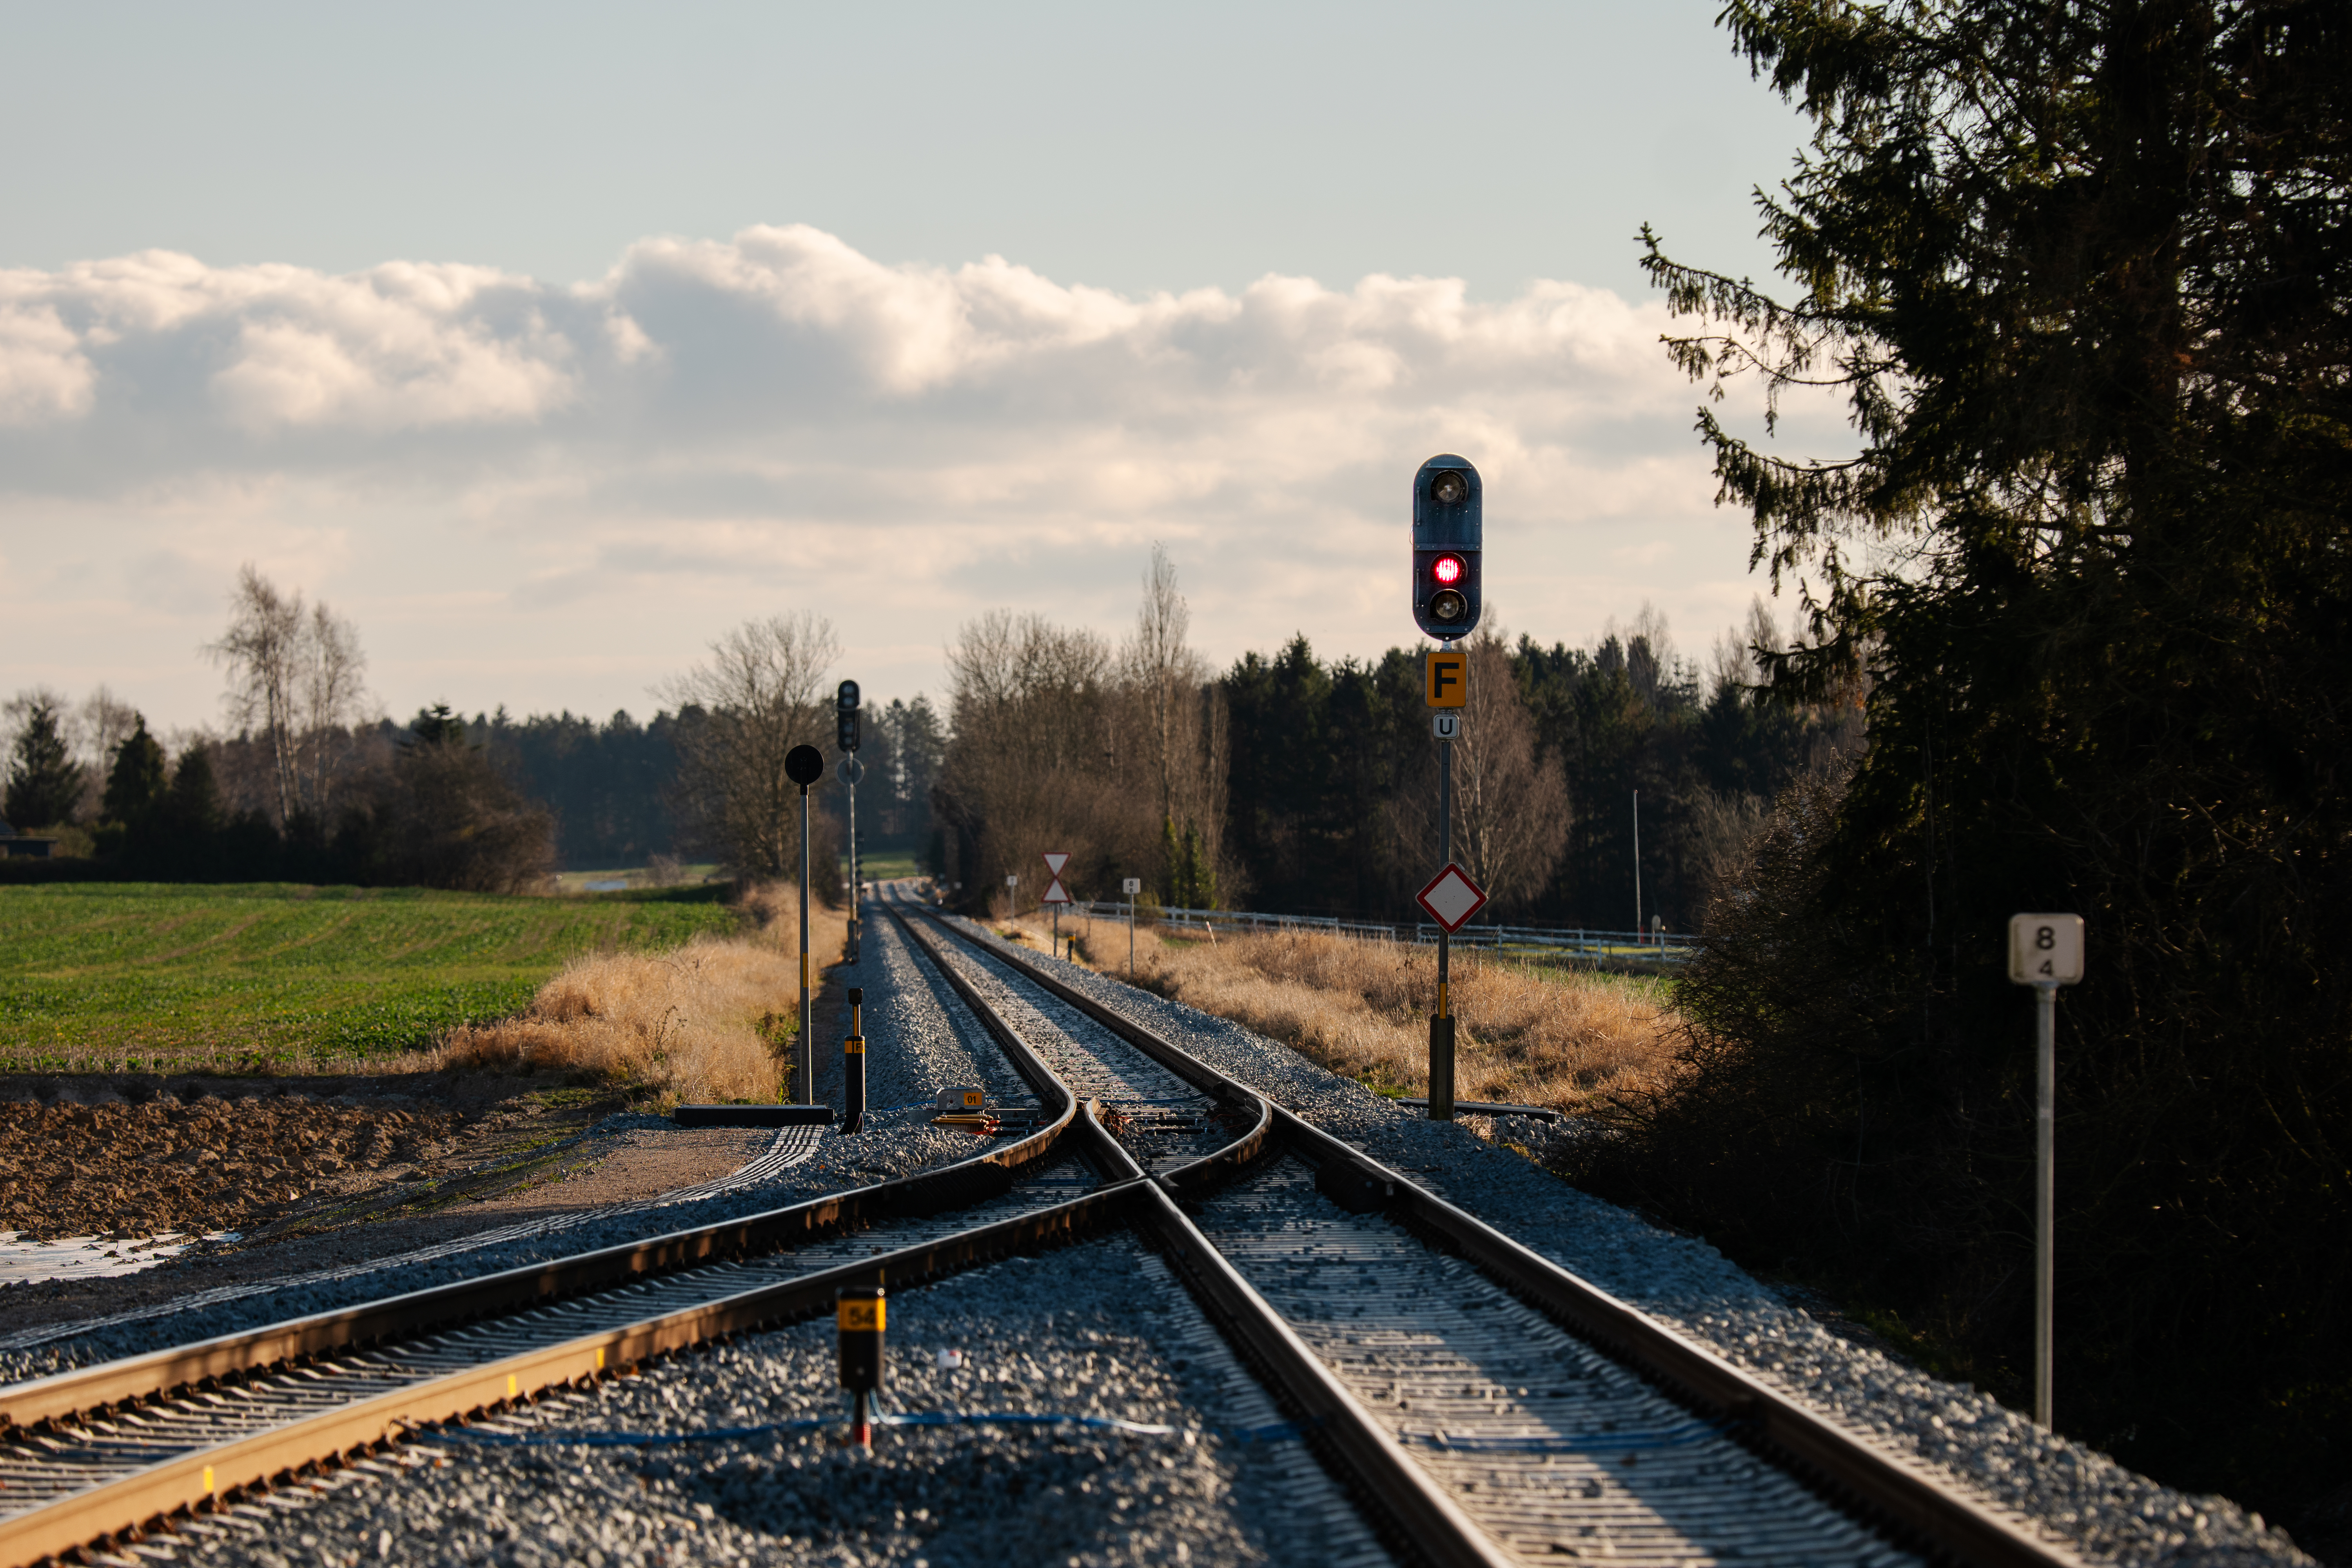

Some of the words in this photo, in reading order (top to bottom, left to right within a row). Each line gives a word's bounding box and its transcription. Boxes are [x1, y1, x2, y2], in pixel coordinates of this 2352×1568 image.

[1434, 662, 1459, 698] F
[1439, 719, 1453, 735] U
[2036, 926, 2055, 950] 8
[2040, 960, 2053, 976] 4
[856, 1043, 861, 1051] F
